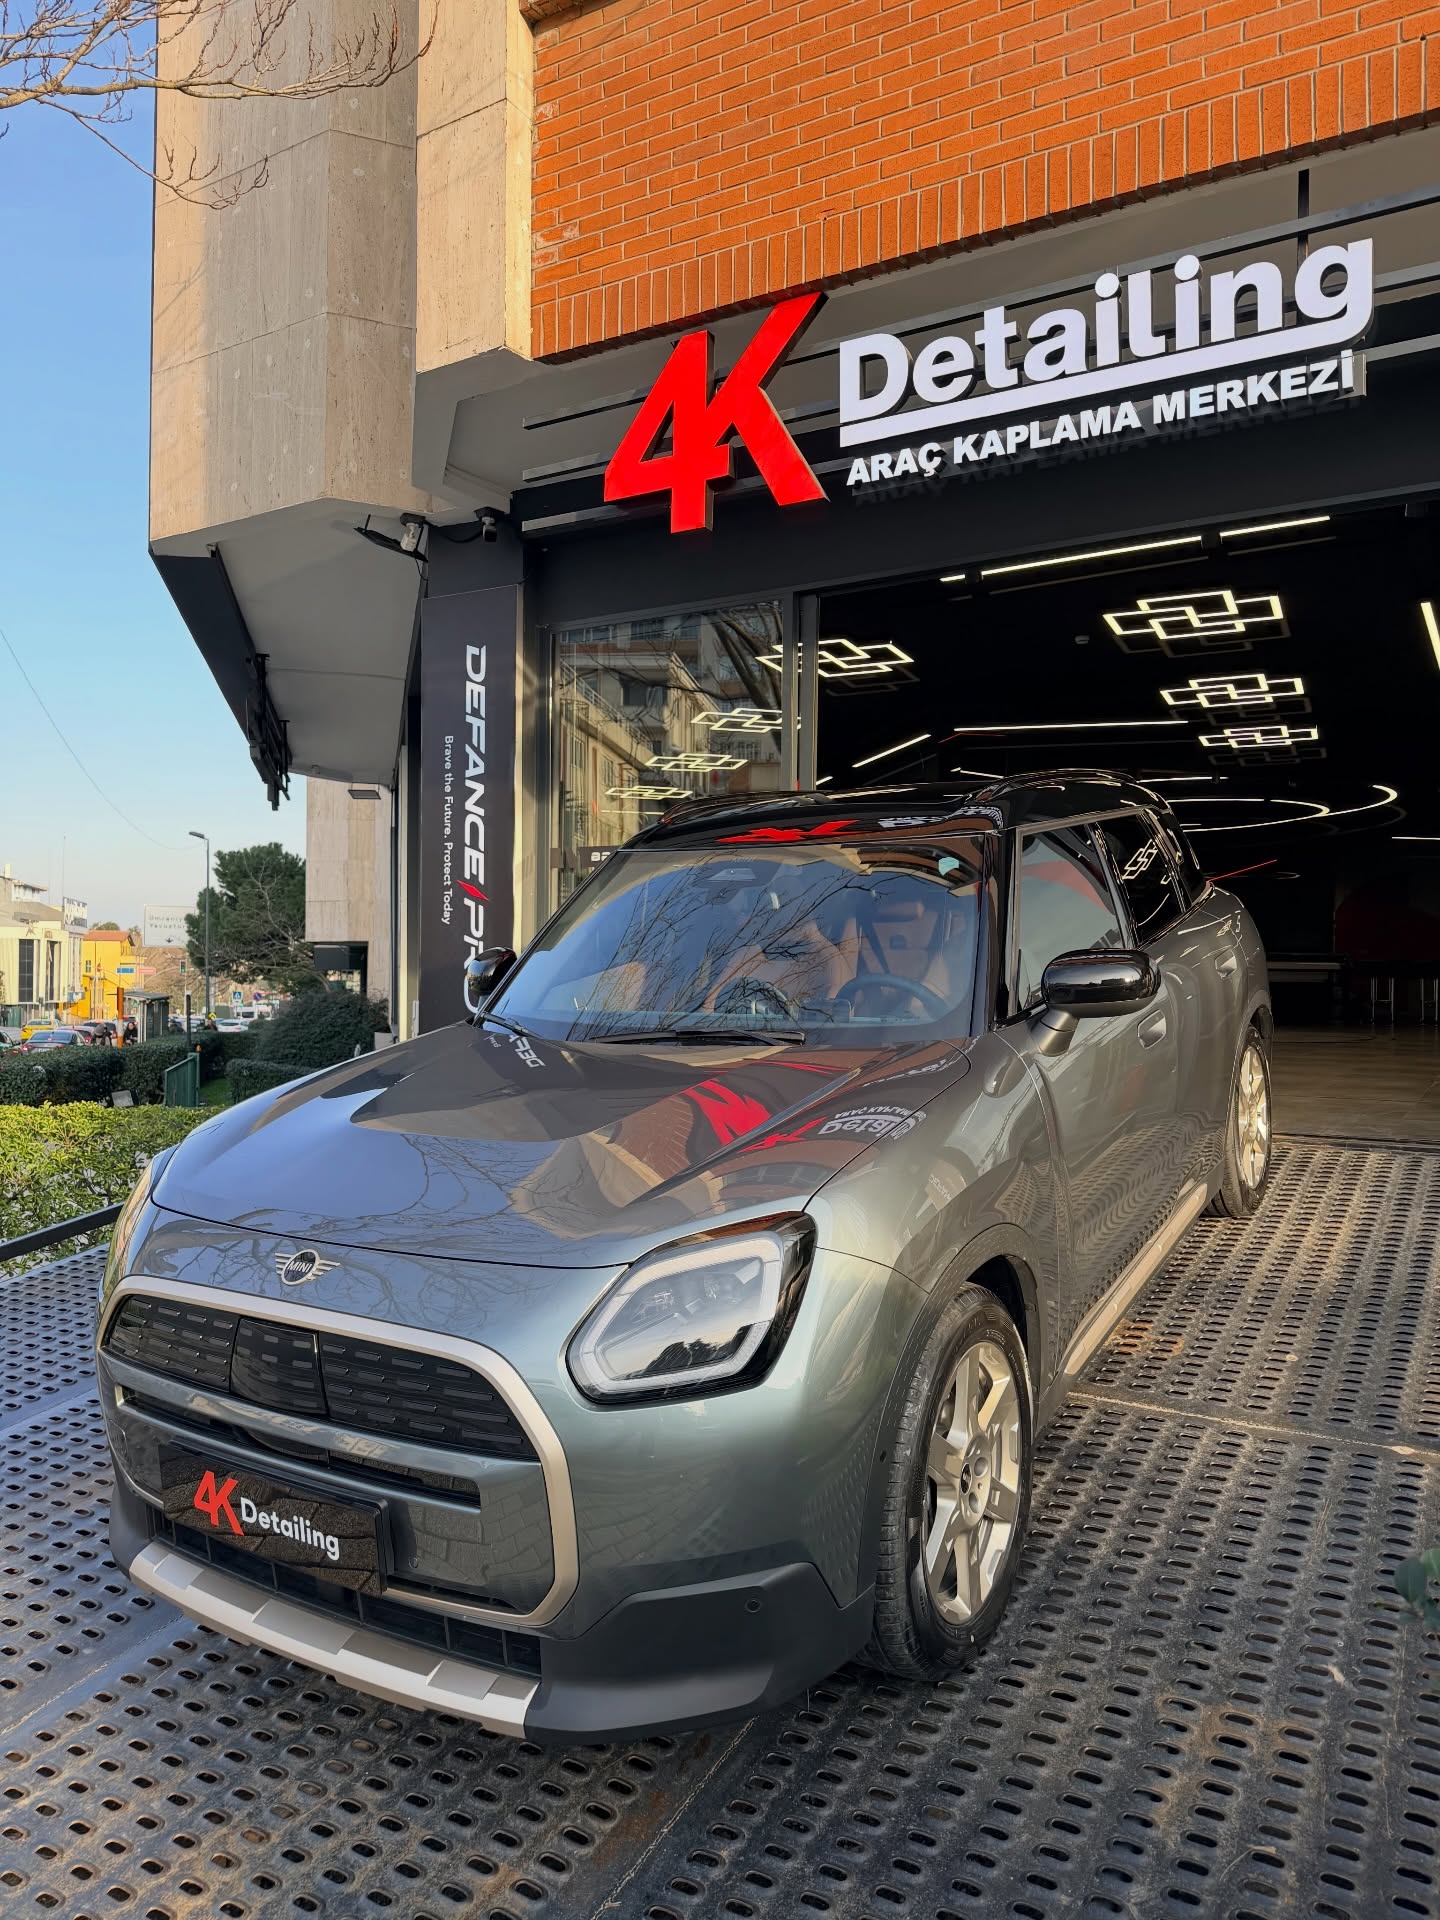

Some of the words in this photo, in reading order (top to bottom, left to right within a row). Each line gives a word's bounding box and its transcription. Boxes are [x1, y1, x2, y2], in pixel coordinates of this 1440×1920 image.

[604, 293, 829, 533] 4K
[839, 238, 1374, 447] Detailing
[847, 442, 942, 486] ARAÇ
[952, 401, 1141, 465] KAPLAMA
[1152, 350, 1355, 425] MERKEZİ
[444, 735, 454, 770] Brave
[444, 773, 455, 793] the
[443, 796, 454, 839] Future.
[443, 842, 454, 886] Protect
[441, 888, 453, 925] Today
[287, 1260, 313, 1273] MINI
[193, 1470, 245, 1536] 4K
[240, 1497, 340, 1561] Detailing
